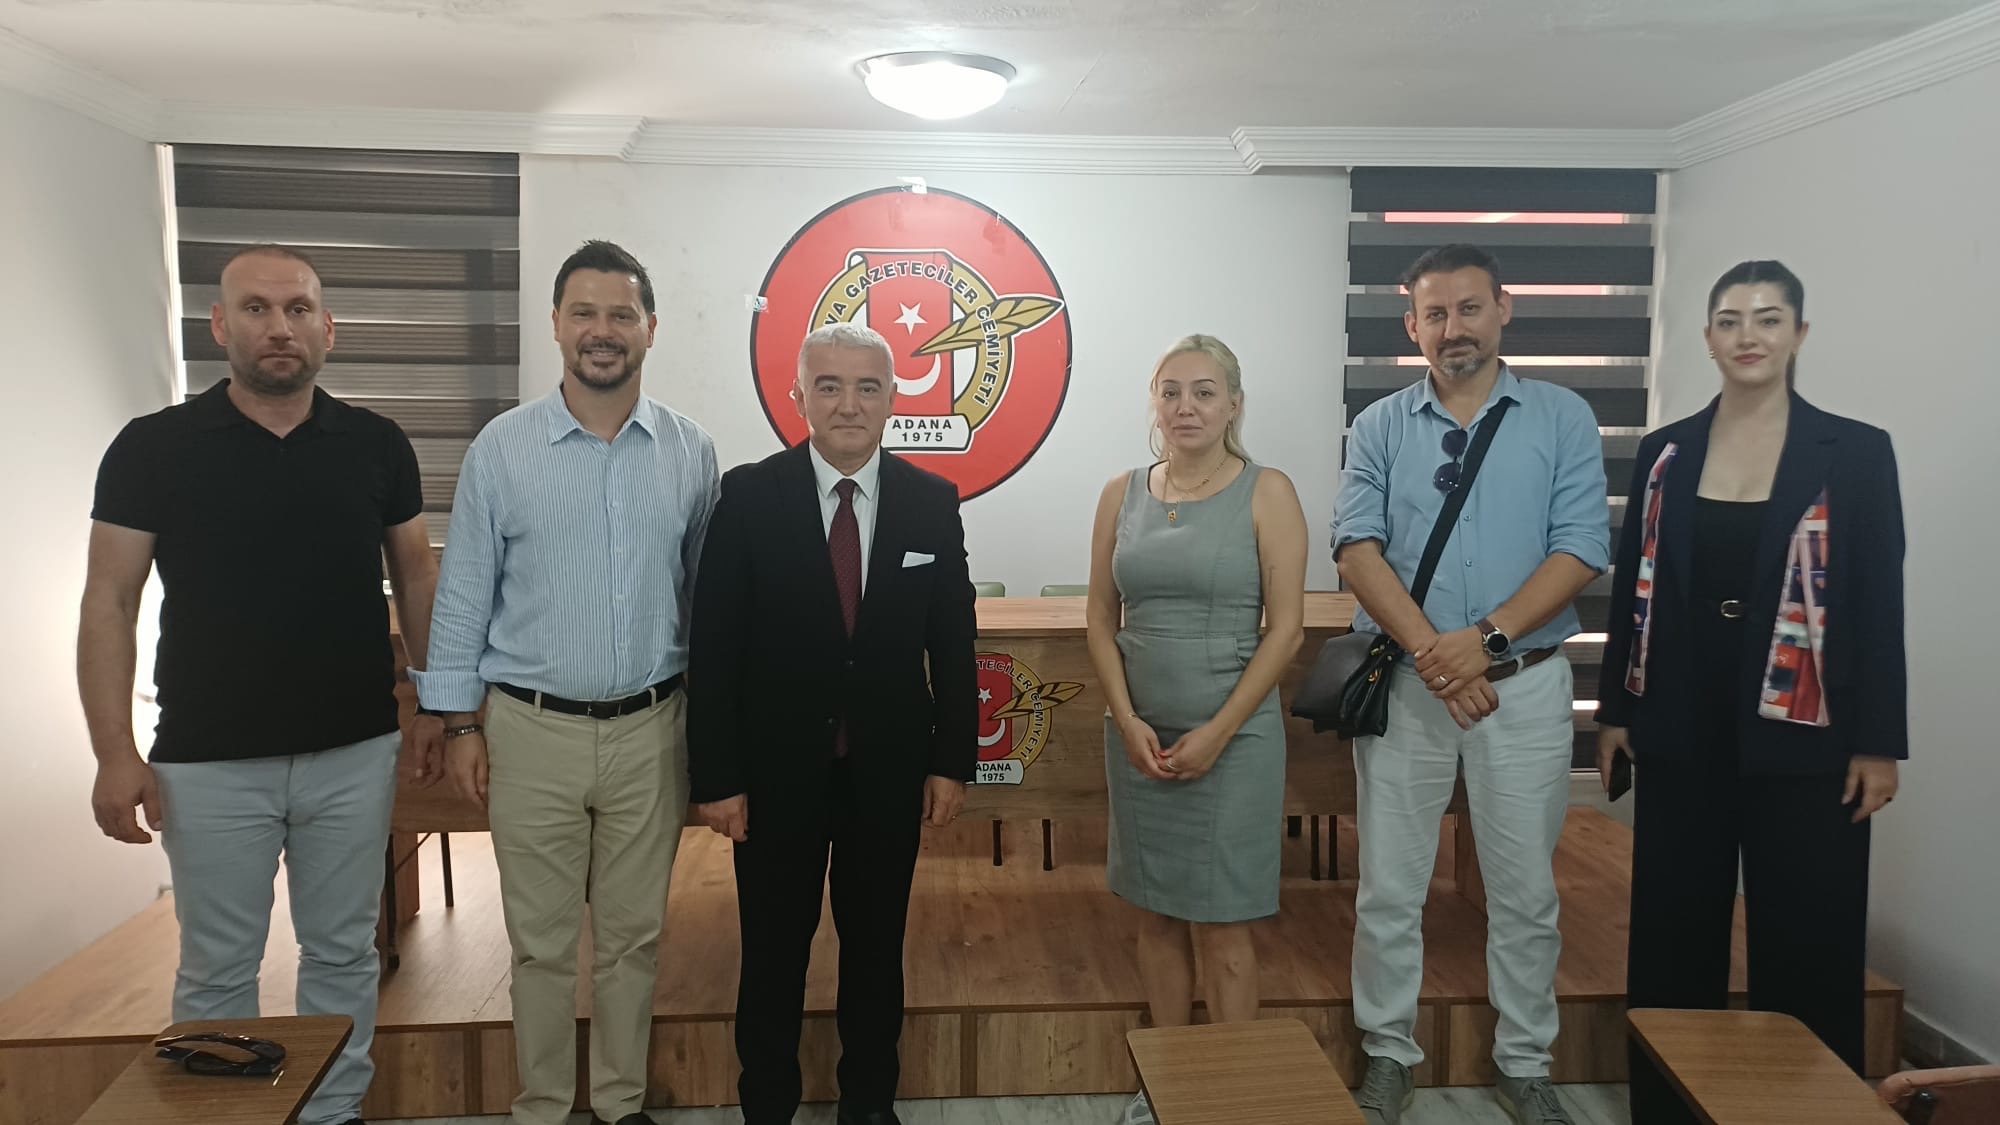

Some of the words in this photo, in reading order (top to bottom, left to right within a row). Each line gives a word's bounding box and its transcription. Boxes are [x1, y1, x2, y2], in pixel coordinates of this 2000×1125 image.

[824, 302, 847, 325] VA
[845, 261, 979, 304] GAZETECİLER
[973, 306, 1004, 407] CEMİYETİ
[892, 420, 952, 430] ADANA
[902, 432, 943, 442] 1975
[975, 763, 1012, 771] ADANA
[982, 773, 1005, 781] 1975
